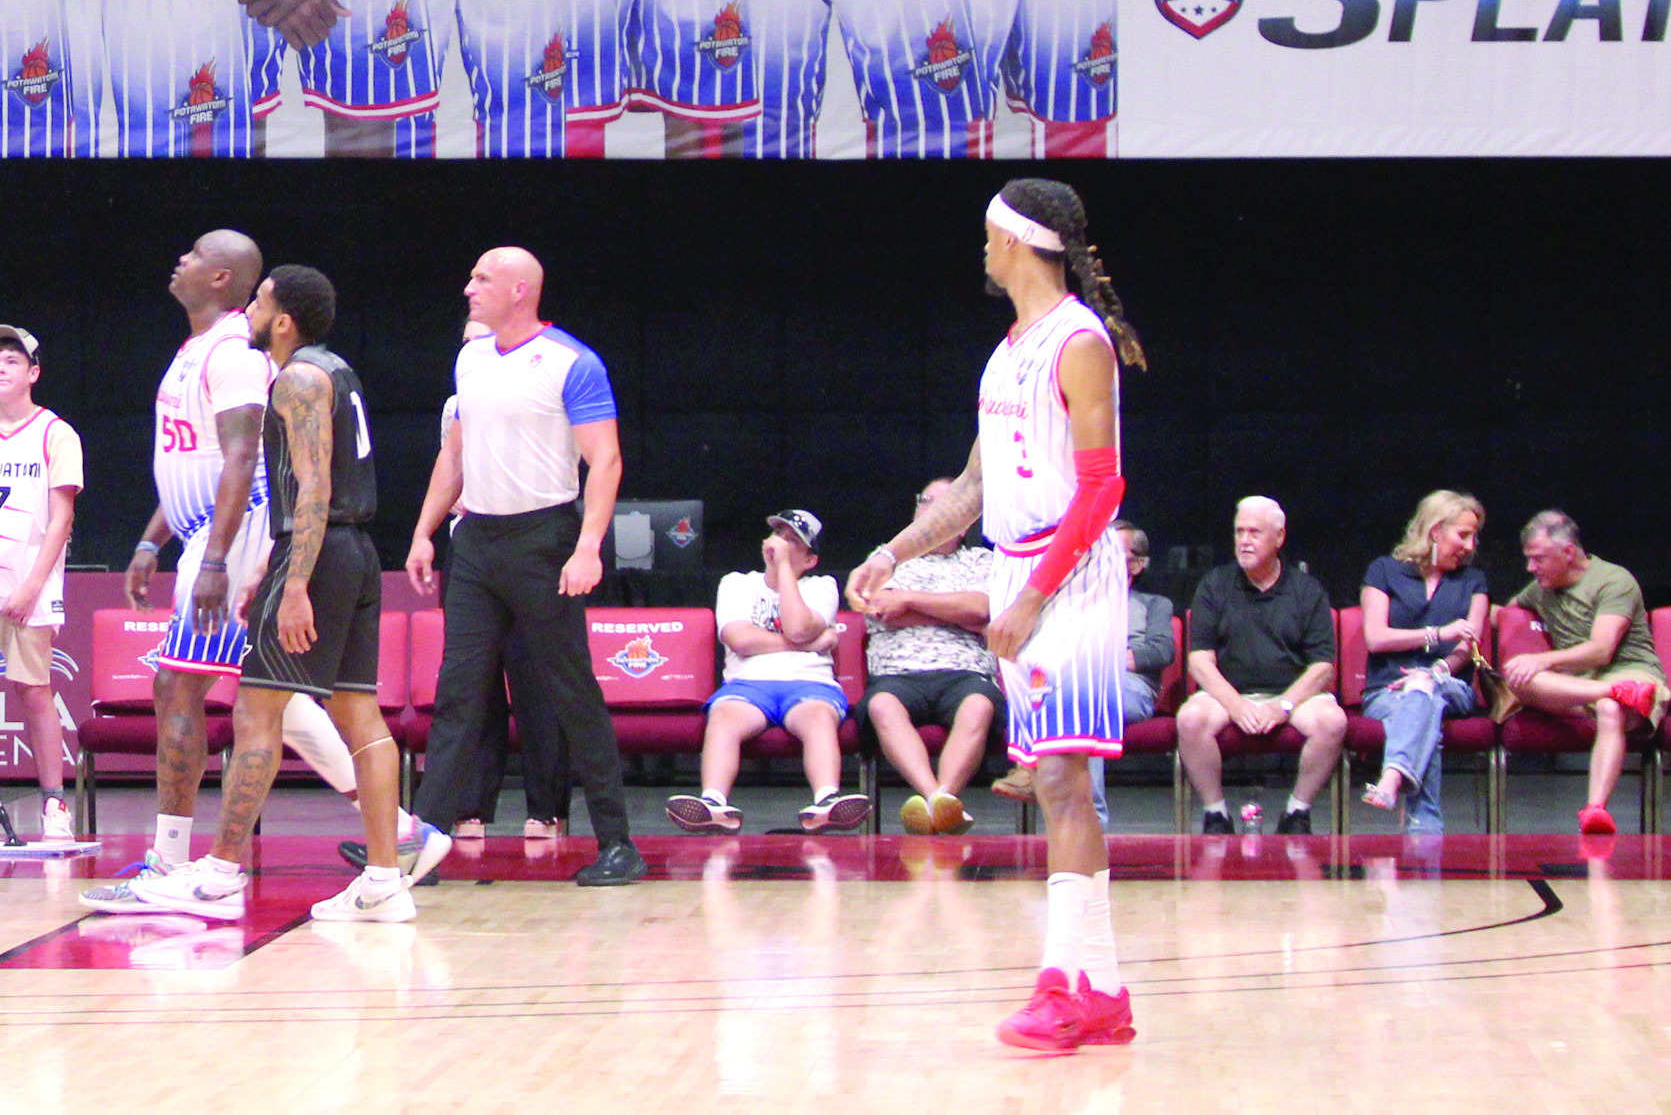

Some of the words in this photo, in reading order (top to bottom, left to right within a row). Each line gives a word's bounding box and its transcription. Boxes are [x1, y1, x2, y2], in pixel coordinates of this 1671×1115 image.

[714, 47, 739, 59] FIRE
[934, 66, 961, 83] FIRE
[22, 83, 49, 96] FIRE
[189, 110, 214, 125] FIRE
[162, 413, 198, 453] 50
[591, 621, 684, 634] RESERVED
